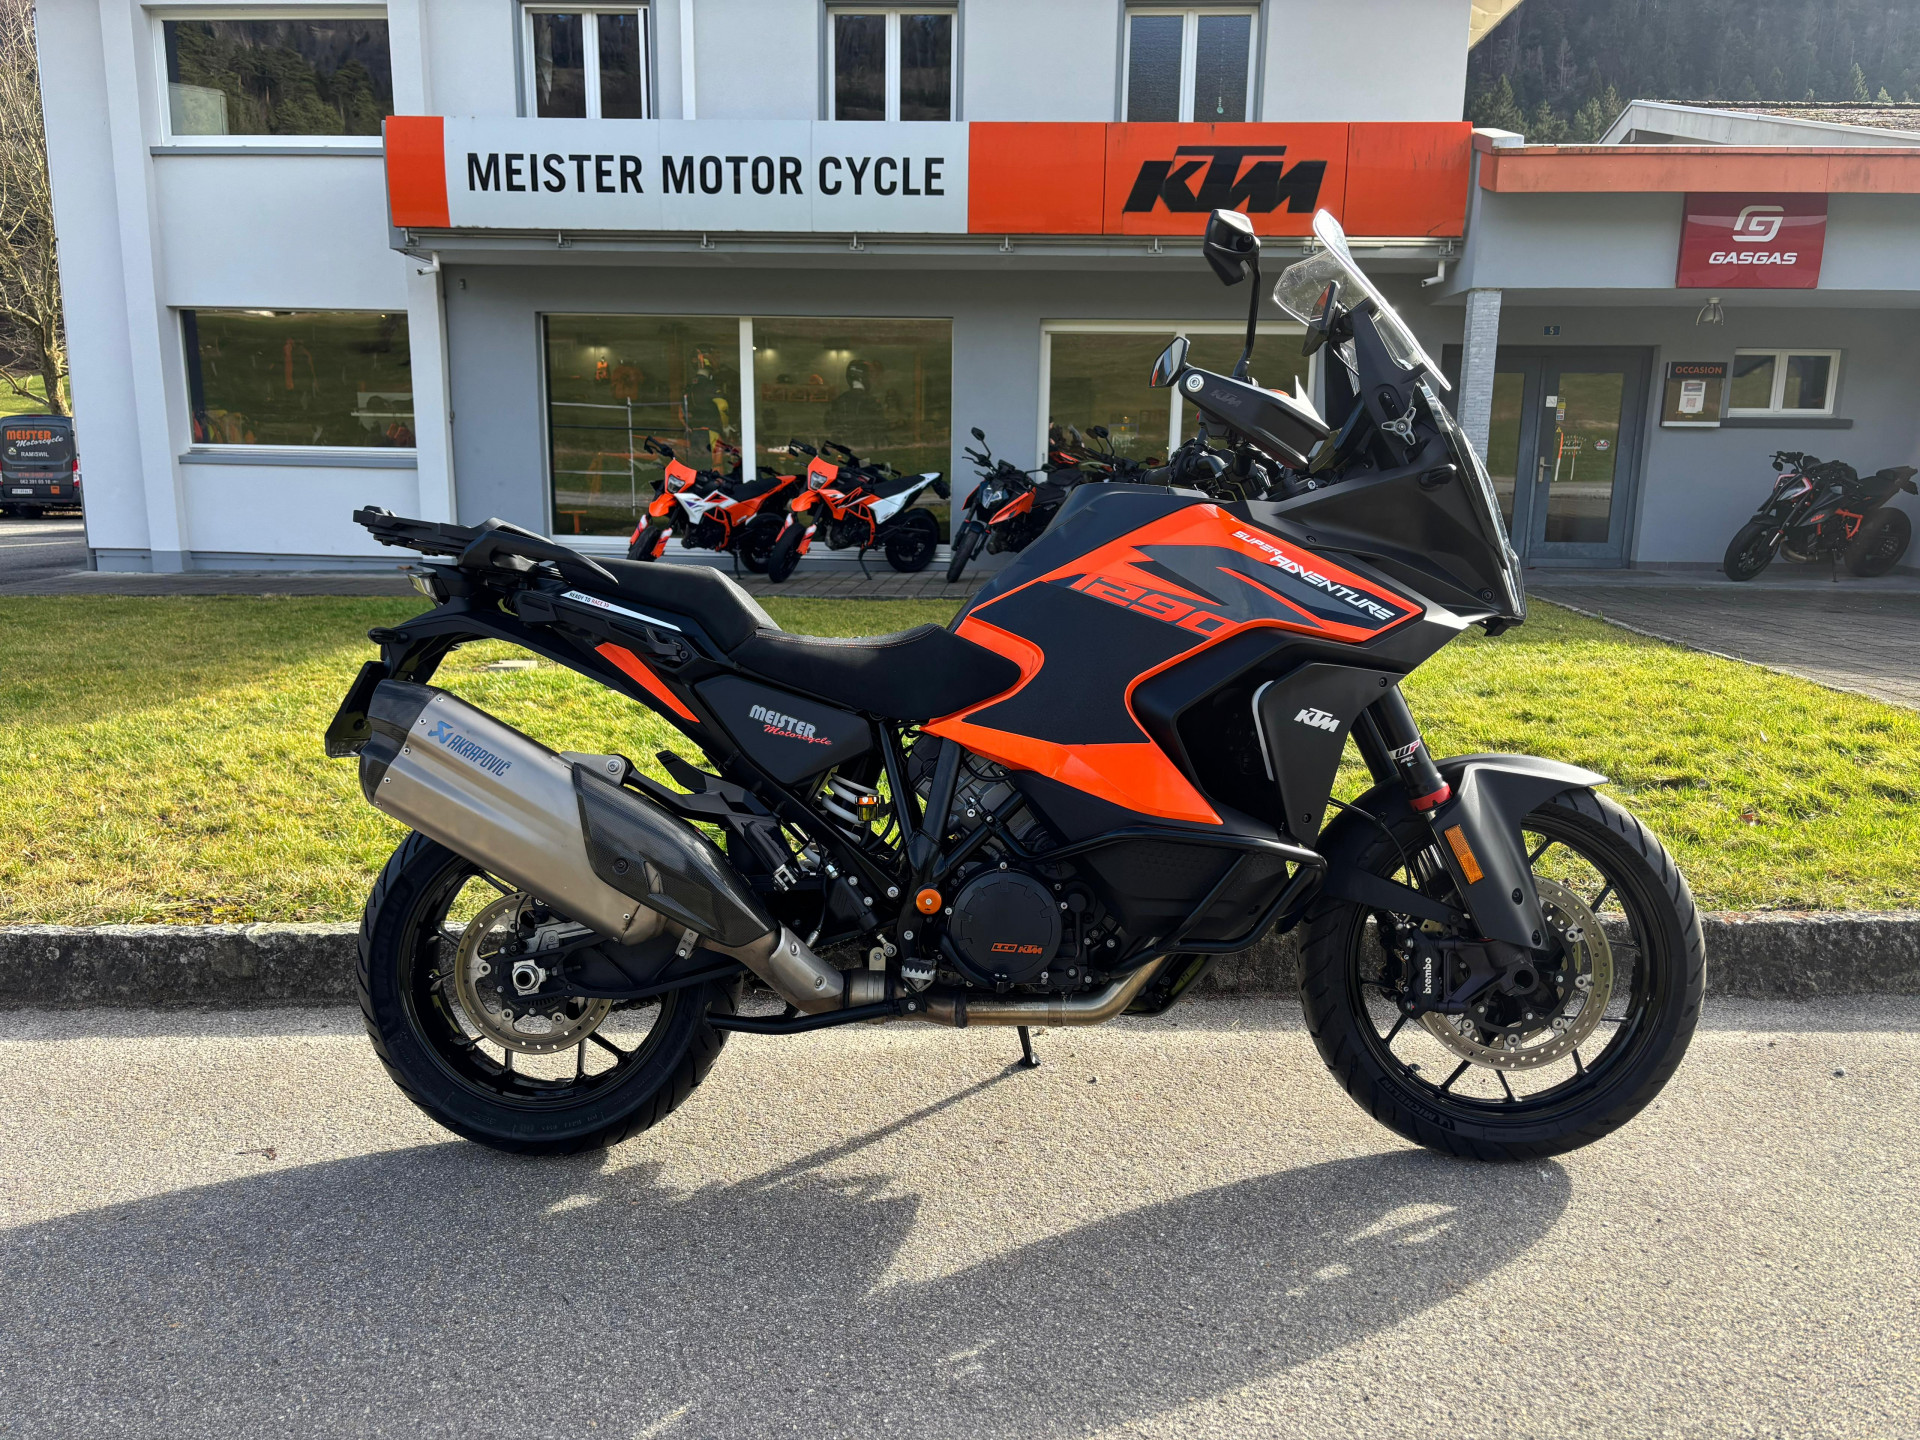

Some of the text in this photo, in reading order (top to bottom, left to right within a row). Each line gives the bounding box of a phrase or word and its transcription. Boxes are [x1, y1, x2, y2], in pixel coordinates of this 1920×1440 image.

[466, 152, 945, 197] MEISTER MOTOR CYCLE
[1123, 145, 1328, 214] KTM
[1708, 251, 1798, 265] GASGAS
[1675, 366, 1722, 374] OCCASION
[1209, 389, 1242, 408] KTM
[6, 430, 52, 440] MEISTER
[15, 435, 64, 447] Motorcycle
[1232, 530, 1283, 556] SUPER
[569, 591, 584, 601] READY
[591, 599, 603, 607] RACE
[1269, 554, 1396, 621] ADVENTURE
[1070, 574, 1240, 638] 1290
[749, 704, 816, 738] MEISTER
[1293, 707, 1340, 733] KTM
[763, 724, 832, 745] Motorcycle
[447, 734, 512, 777] AKRAPOVIČ
[1395, 741, 1419, 758] WP
[1018, 945, 1043, 954] KTM
[1422, 957, 1432, 994] brembo
[1381, 1079, 1437, 1120] MICHELIN
